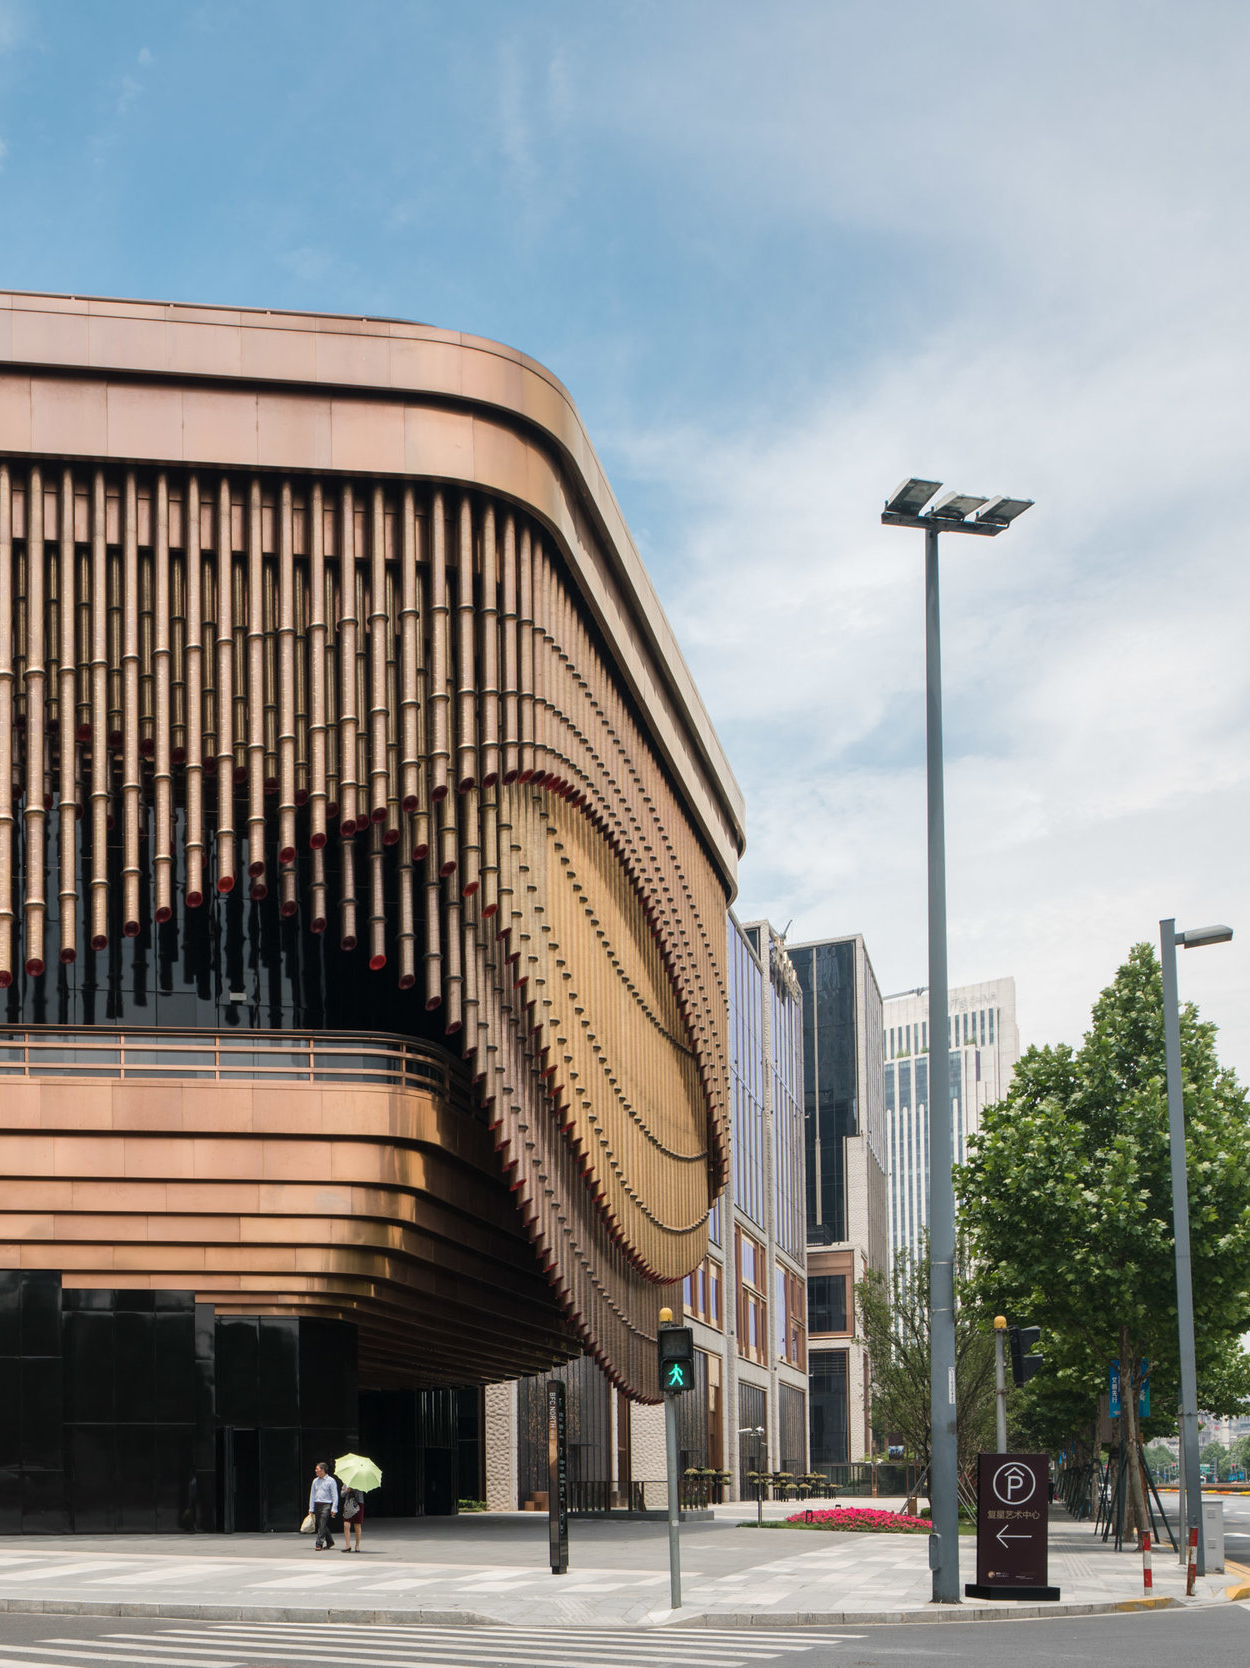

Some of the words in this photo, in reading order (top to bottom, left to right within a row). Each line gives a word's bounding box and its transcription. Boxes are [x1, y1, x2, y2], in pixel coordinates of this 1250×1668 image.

[549, 1392, 557, 1405] BFC
[549, 1406, 557, 1428] NORTH
[1007, 1475, 1024, 1500] P
[987, 1510, 1040, 1520] 复星艺术中心
